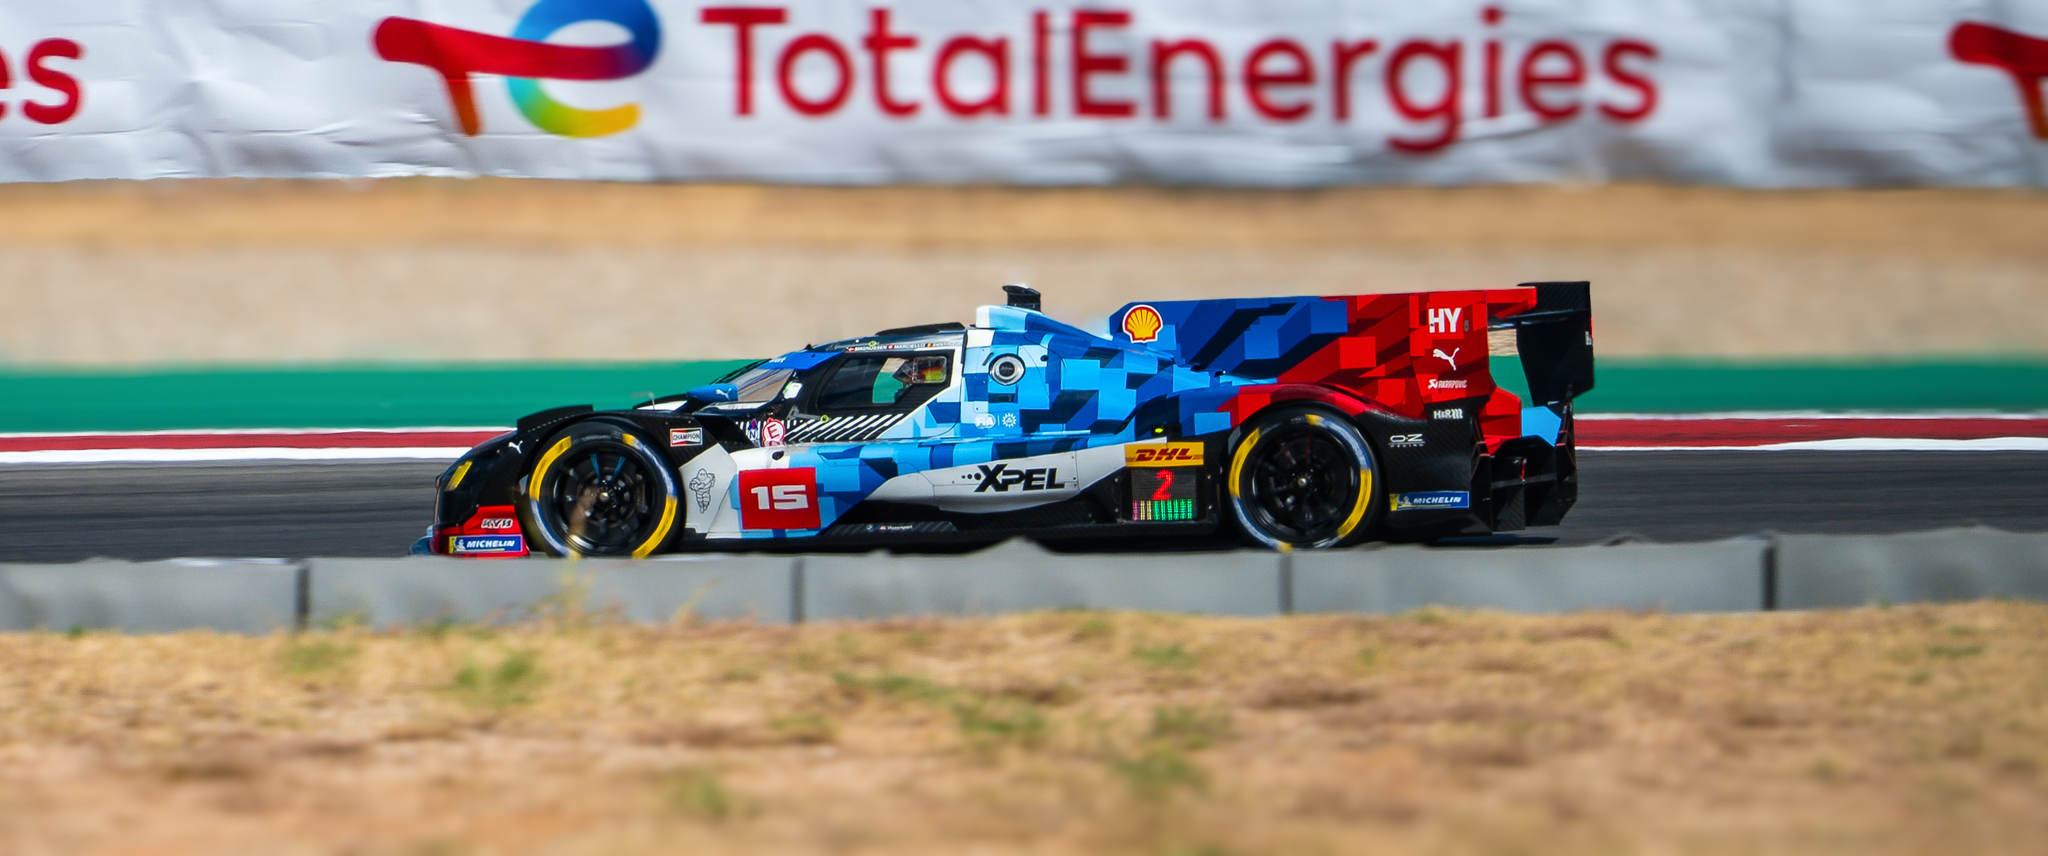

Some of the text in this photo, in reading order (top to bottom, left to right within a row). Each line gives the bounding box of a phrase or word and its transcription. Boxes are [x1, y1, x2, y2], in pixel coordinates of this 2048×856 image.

[0, 36, 84, 124] s
[700, 7, 1660, 155] TotalEnergies
[1428, 307, 1462, 333] HY
[672, 432, 700, 441] CHAMPION
[767, 423, 780, 440] E
[1135, 447, 1195, 462] DHL
[973, 463, 1066, 493] XPEL
[1152, 469, 1173, 501] 2
[751, 484, 809, 510] 15
[1413, 496, 1462, 504] MICHELIN
[481, 518, 514, 529] KYB
[466, 540, 516, 549] MICHELIN
